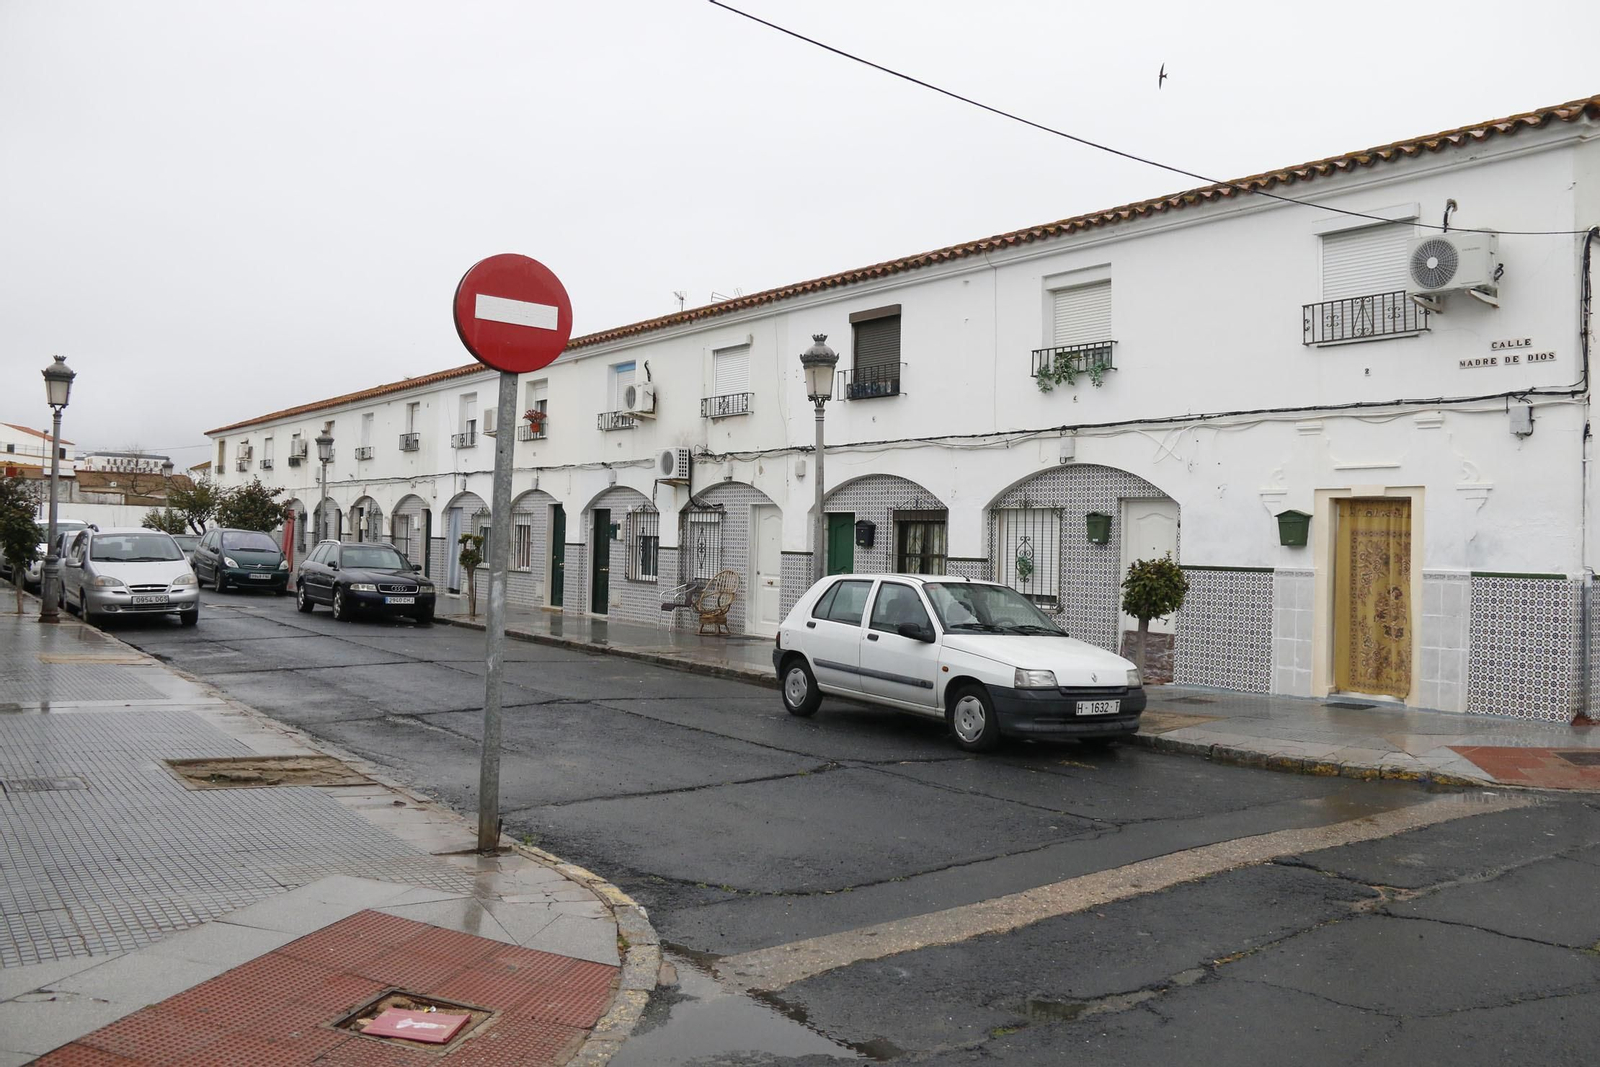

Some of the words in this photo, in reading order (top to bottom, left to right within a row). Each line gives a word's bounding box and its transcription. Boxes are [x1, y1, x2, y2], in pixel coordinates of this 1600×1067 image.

[1491, 338, 1532, 349] CALLE
[1459, 357, 1498, 368] MADRE
[1504, 355, 1520, 364] DE
[1527, 351, 1556, 362] DIOS
